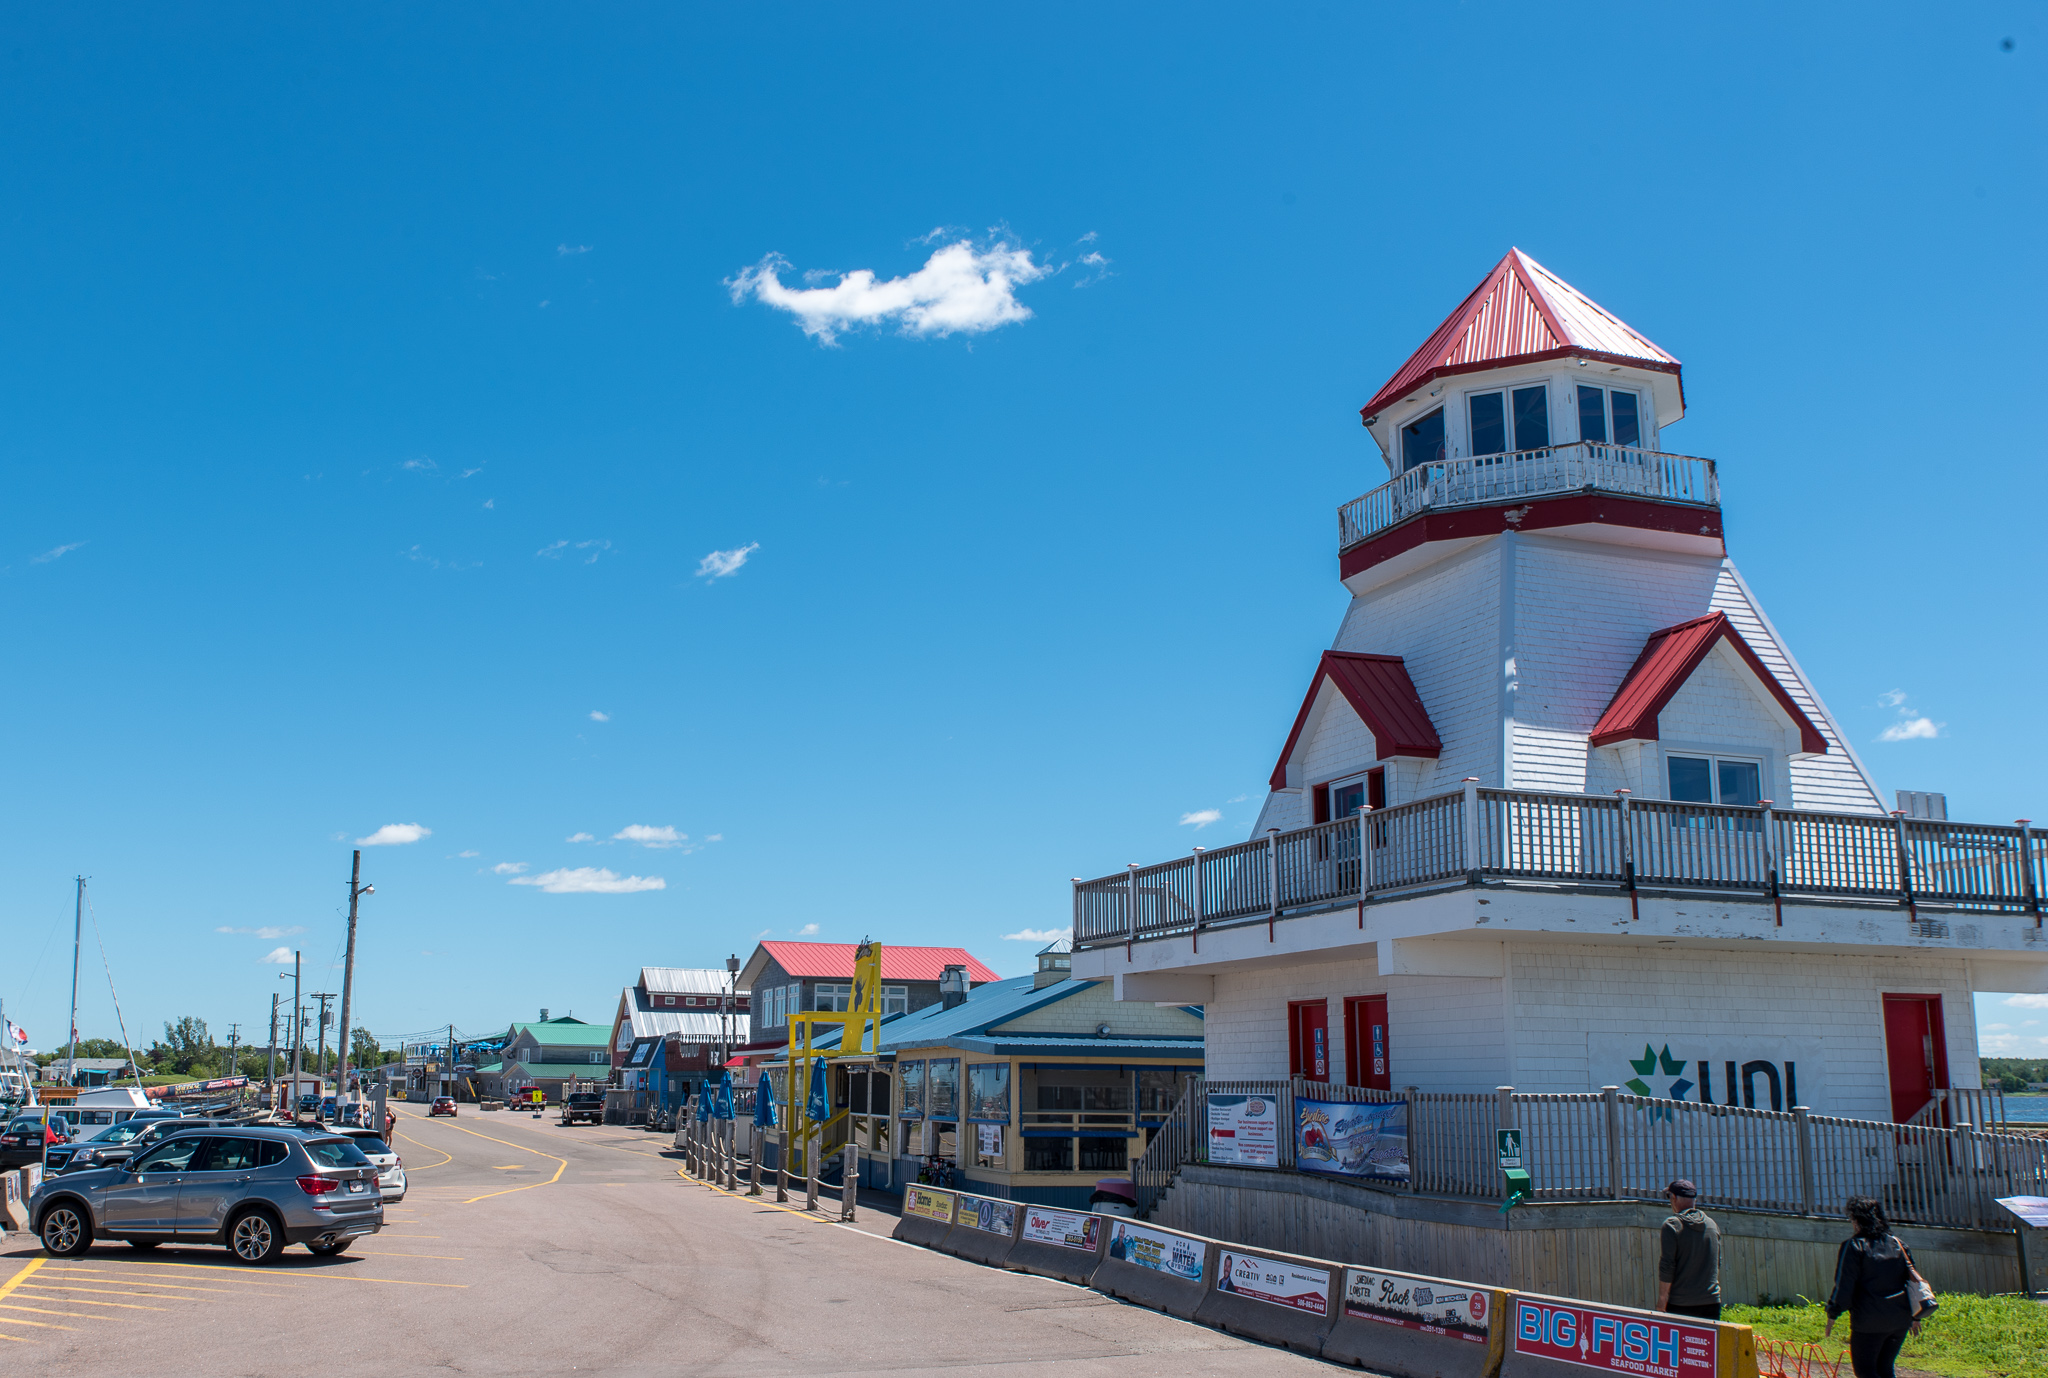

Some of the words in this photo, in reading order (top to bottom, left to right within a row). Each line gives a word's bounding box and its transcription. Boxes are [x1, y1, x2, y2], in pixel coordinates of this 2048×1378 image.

[916, 1191, 932, 1207] Home
[1031, 1216, 1050, 1229] Oliver
[1173, 1247, 1197, 1257] PREMIUM
[1172, 1252, 1195, 1267] WATER
[1310, 1276, 1326, 1284] Commercial
[1355, 1275, 1375, 1286] SHEDIAC
[1349, 1285, 1371, 1297] LOBSTER
[1379, 1279, 1410, 1306] Rock
[1440, 1316, 1462, 1325] WRECK
[1518, 1304, 1576, 1348] BIG
[1592, 1316, 1680, 1368] FISH
[1684, 1335, 1707, 1345] SHEDIAC
[1686, 1347, 1706, 1357] DIEPPE
[1610, 1358, 1644, 1372] SEAFOOD
[1646, 1364, 1679, 1378] MARKET
[1683, 1357, 1709, 1368] MONCTON
